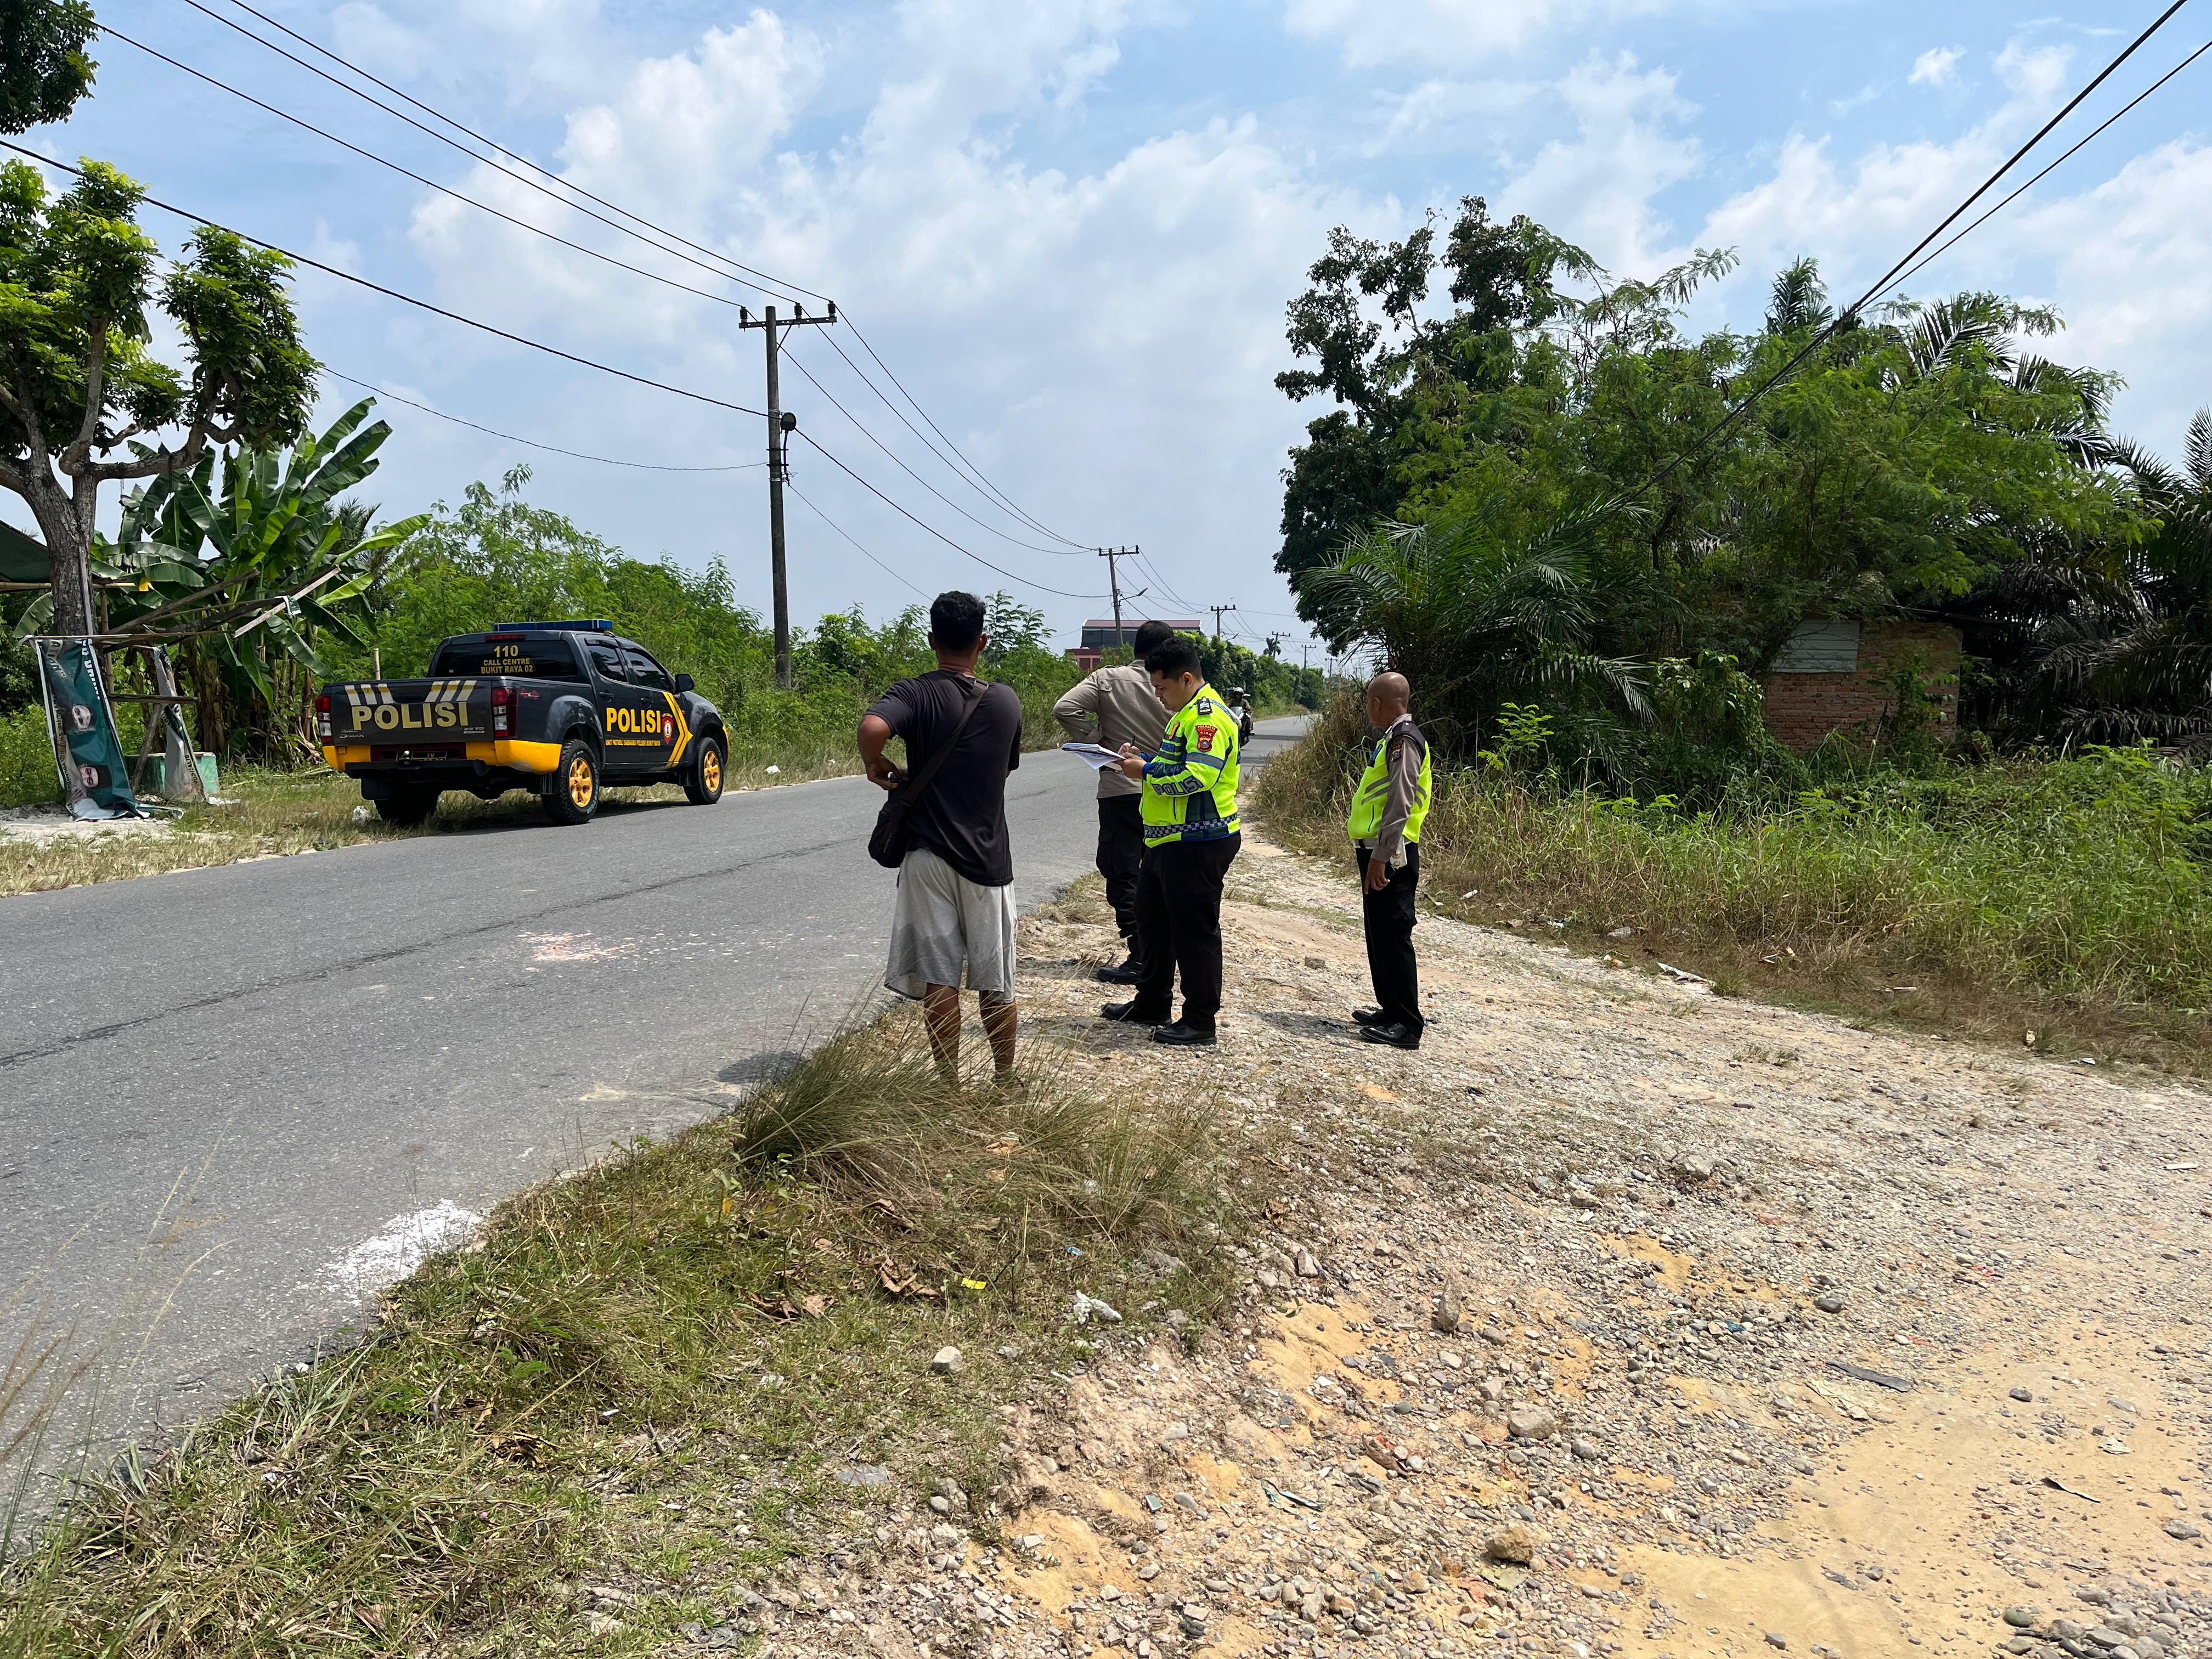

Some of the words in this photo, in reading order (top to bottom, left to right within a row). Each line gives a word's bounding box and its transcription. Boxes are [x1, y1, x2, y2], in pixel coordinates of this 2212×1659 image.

[494, 645, 518, 657] 110
[352, 701, 469, 730] POLISI
[606, 707, 661, 733] POLISI
[1152, 775, 1204, 795] POLISI
